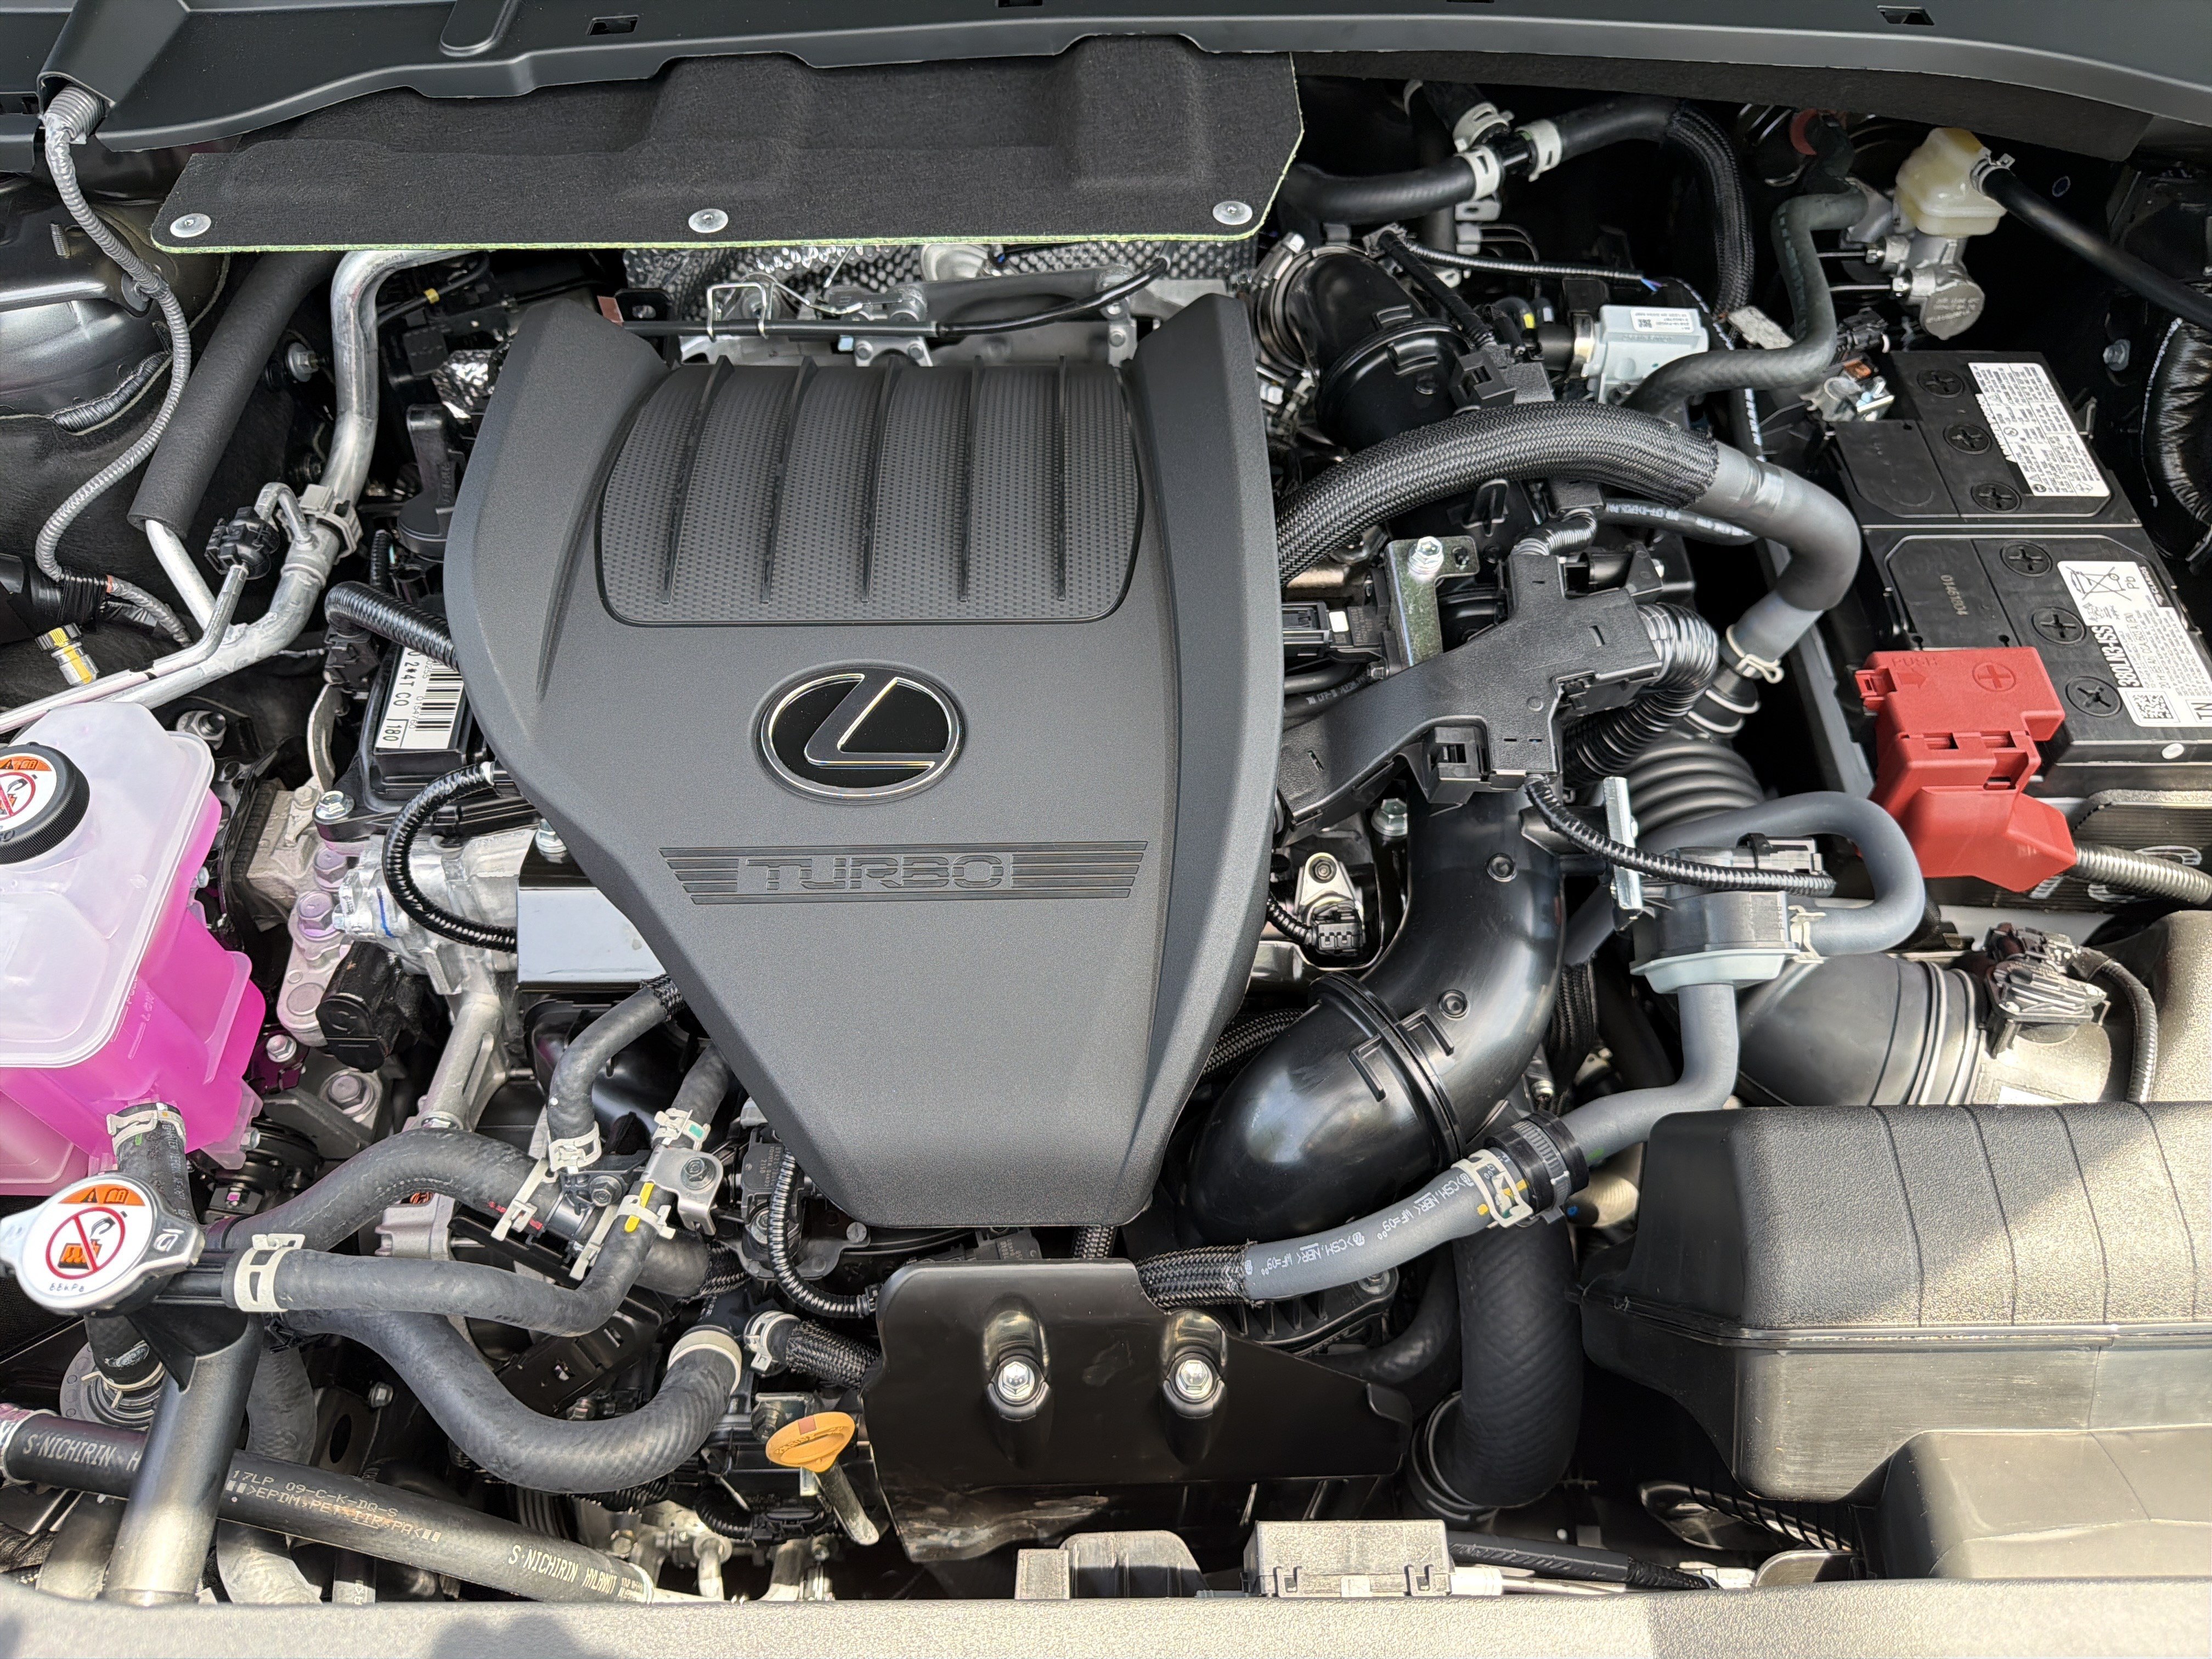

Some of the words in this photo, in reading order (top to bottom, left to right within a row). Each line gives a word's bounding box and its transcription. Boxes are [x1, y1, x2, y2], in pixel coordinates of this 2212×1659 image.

[2125, 576, 2139, 589] Pb
[2091, 625, 2140, 686] 380LN3-ISS
[408, 696, 424, 729] 0154760
[382, 725, 402, 741] 180
[746, 855, 1003, 890] TURBO
[140, 991, 154, 1022] LOW
[233, 1470, 274, 1485] 17LP
[285, 1482, 399, 1517] 09-C-K-DQ-S
